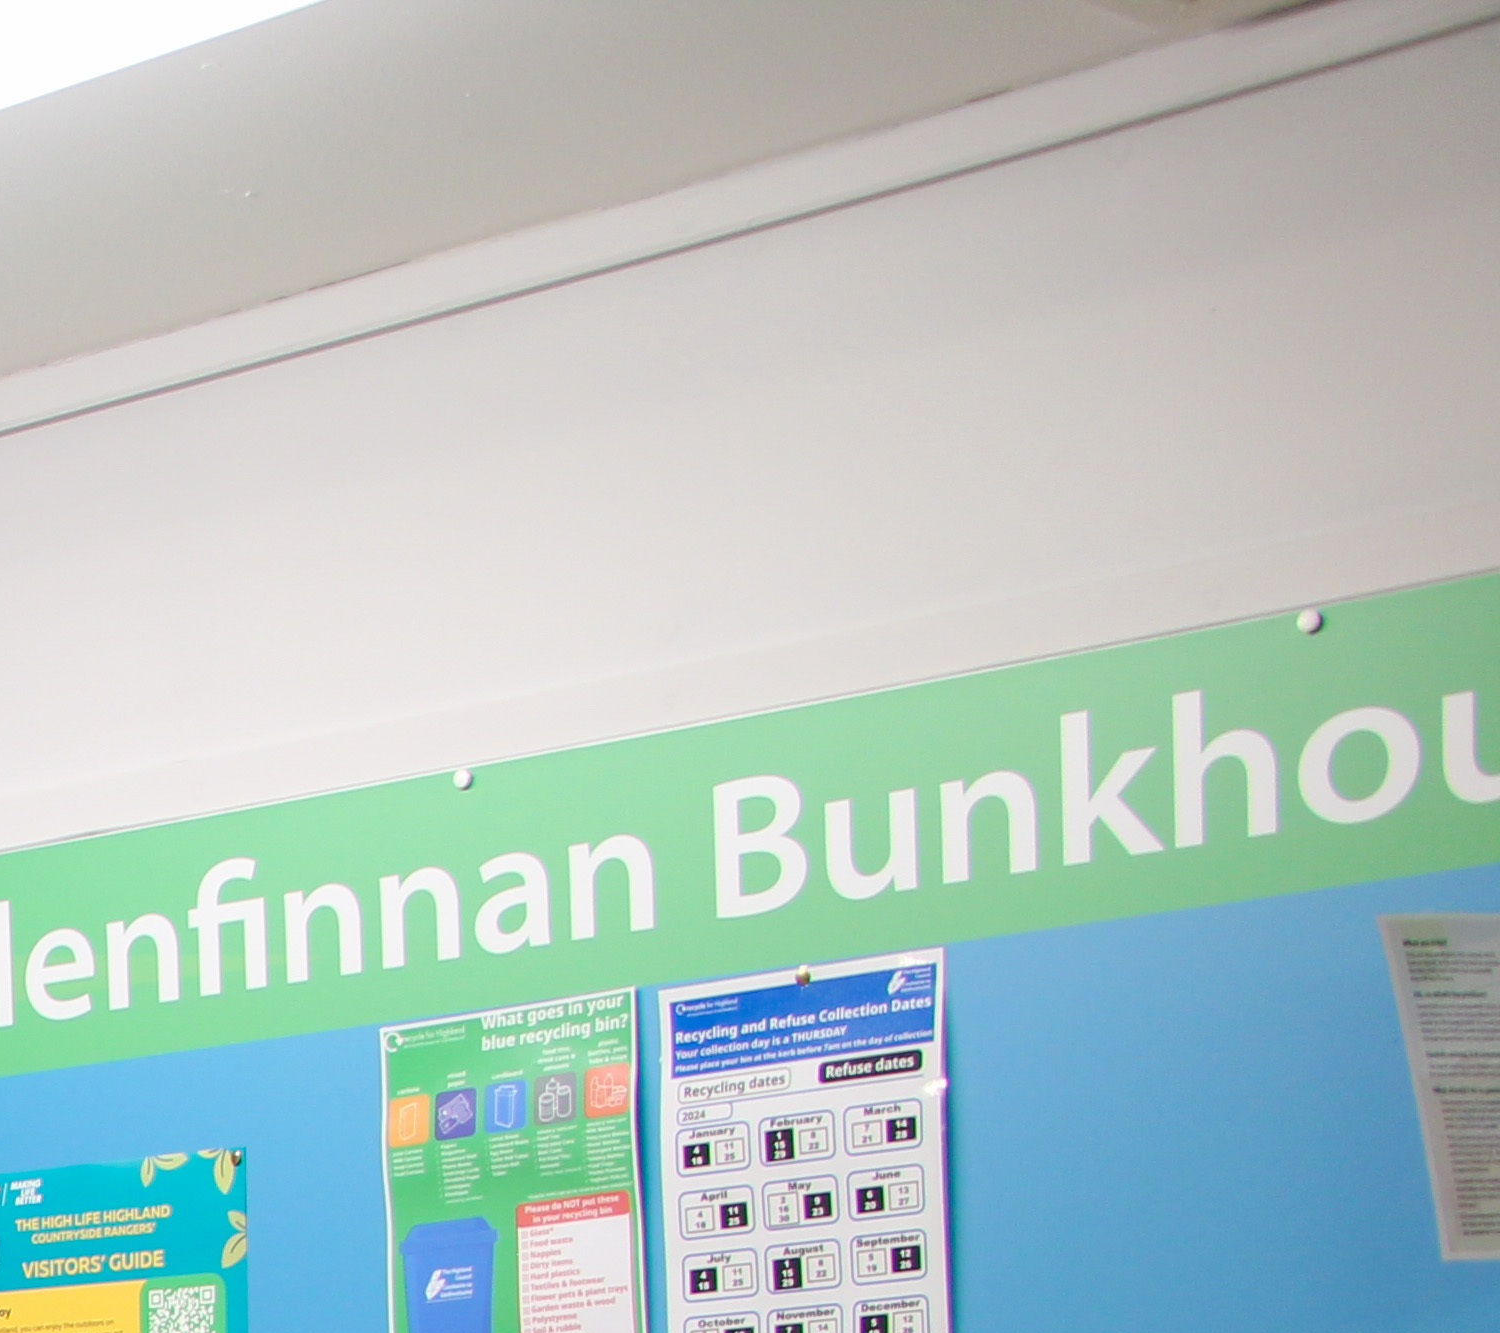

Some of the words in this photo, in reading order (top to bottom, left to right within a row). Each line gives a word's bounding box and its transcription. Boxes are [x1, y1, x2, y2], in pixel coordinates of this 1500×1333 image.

[711, 689, 1500, 921] Bunkhou
[481, 1011, 522, 1029] What
[527, 1008, 563, 1025] goes
[568, 1003, 582, 1015] in
[587, 998, 624, 1015] your
[675, 1024, 737, 1042] Recycling
[741, 1018, 766, 1033] and
[769, 1015, 815, 1029] Refuse
[819, 1004, 887, 1022] Collection
[891, 997, 931, 1012] Dates
[482, 1036, 515, 1050] blue
[519, 1025, 591, 1044] recycling
[595, 1016, 627, 1032] bin?
[675, 1048, 697, 1059] Your
[700, 1040, 748, 1056] collection
[751, 1037, 769, 1049] day
[772, 1035, 780, 1045] is
[783, 1036, 789, 1044] a
[792, 1024, 846, 1042] THURSDAY
[675, 1063, 698, 1071] Please
[699, 1059, 719, 1070] place
[721, 1057, 738, 1067] your
[762, 1051, 776, 1059] the
[796, 1046, 822, 1055] before
[852, 1038, 866, 1047] the
[868, 1037, 882, 1046] day
[884, 1034, 892, 1043] of
[894, 1030, 932, 1042] collection
[826, 1062, 871, 1076] Refuse
[875, 1056, 913, 1070] dates
[684, 1079, 744, 1096] Recycling
[749, 1074, 785, 1088] dates
[864, 1104, 900, 1114] March
[682, 1111, 705, 1121] 2024
[770, 1116, 822, 1127] February
[689, 1128, 735, 1137] January
[873, 1170, 900, 1178] June
[11, 1179, 41, 1190] MAKING
[789, 1181, 811, 1191] May
[21, 1188, 35, 1197] LIFE
[701, 1190, 727, 1202] April
[16, 1195, 42, 1205] BETTER
[563, 1199, 579, 1207] NOT
[582, 1197, 595, 1207] put
[16, 1217, 39, 1231] THE
[41, 1214, 72, 1229] HIGH
[74, 1212, 100, 1226] LIFE
[103, 1205, 171, 1223] HIGHLAND
[542, 1215, 559, 1223] your
[562, 1210, 597, 1219] recycling
[32, 1228, 102, 1243] COUNTRYSIDE
[857, 1234, 919, 1247] September
[783, 1244, 824, 1255] August
[708, 1253, 731, 1263] July
[23, 1256, 107, 1277] VISITORS'
[109, 1251, 164, 1271] GUIDE
[861, 1300, 919, 1310] December
[777, 1308, 834, 1319] November
[698, 1316, 745, 1326] October
